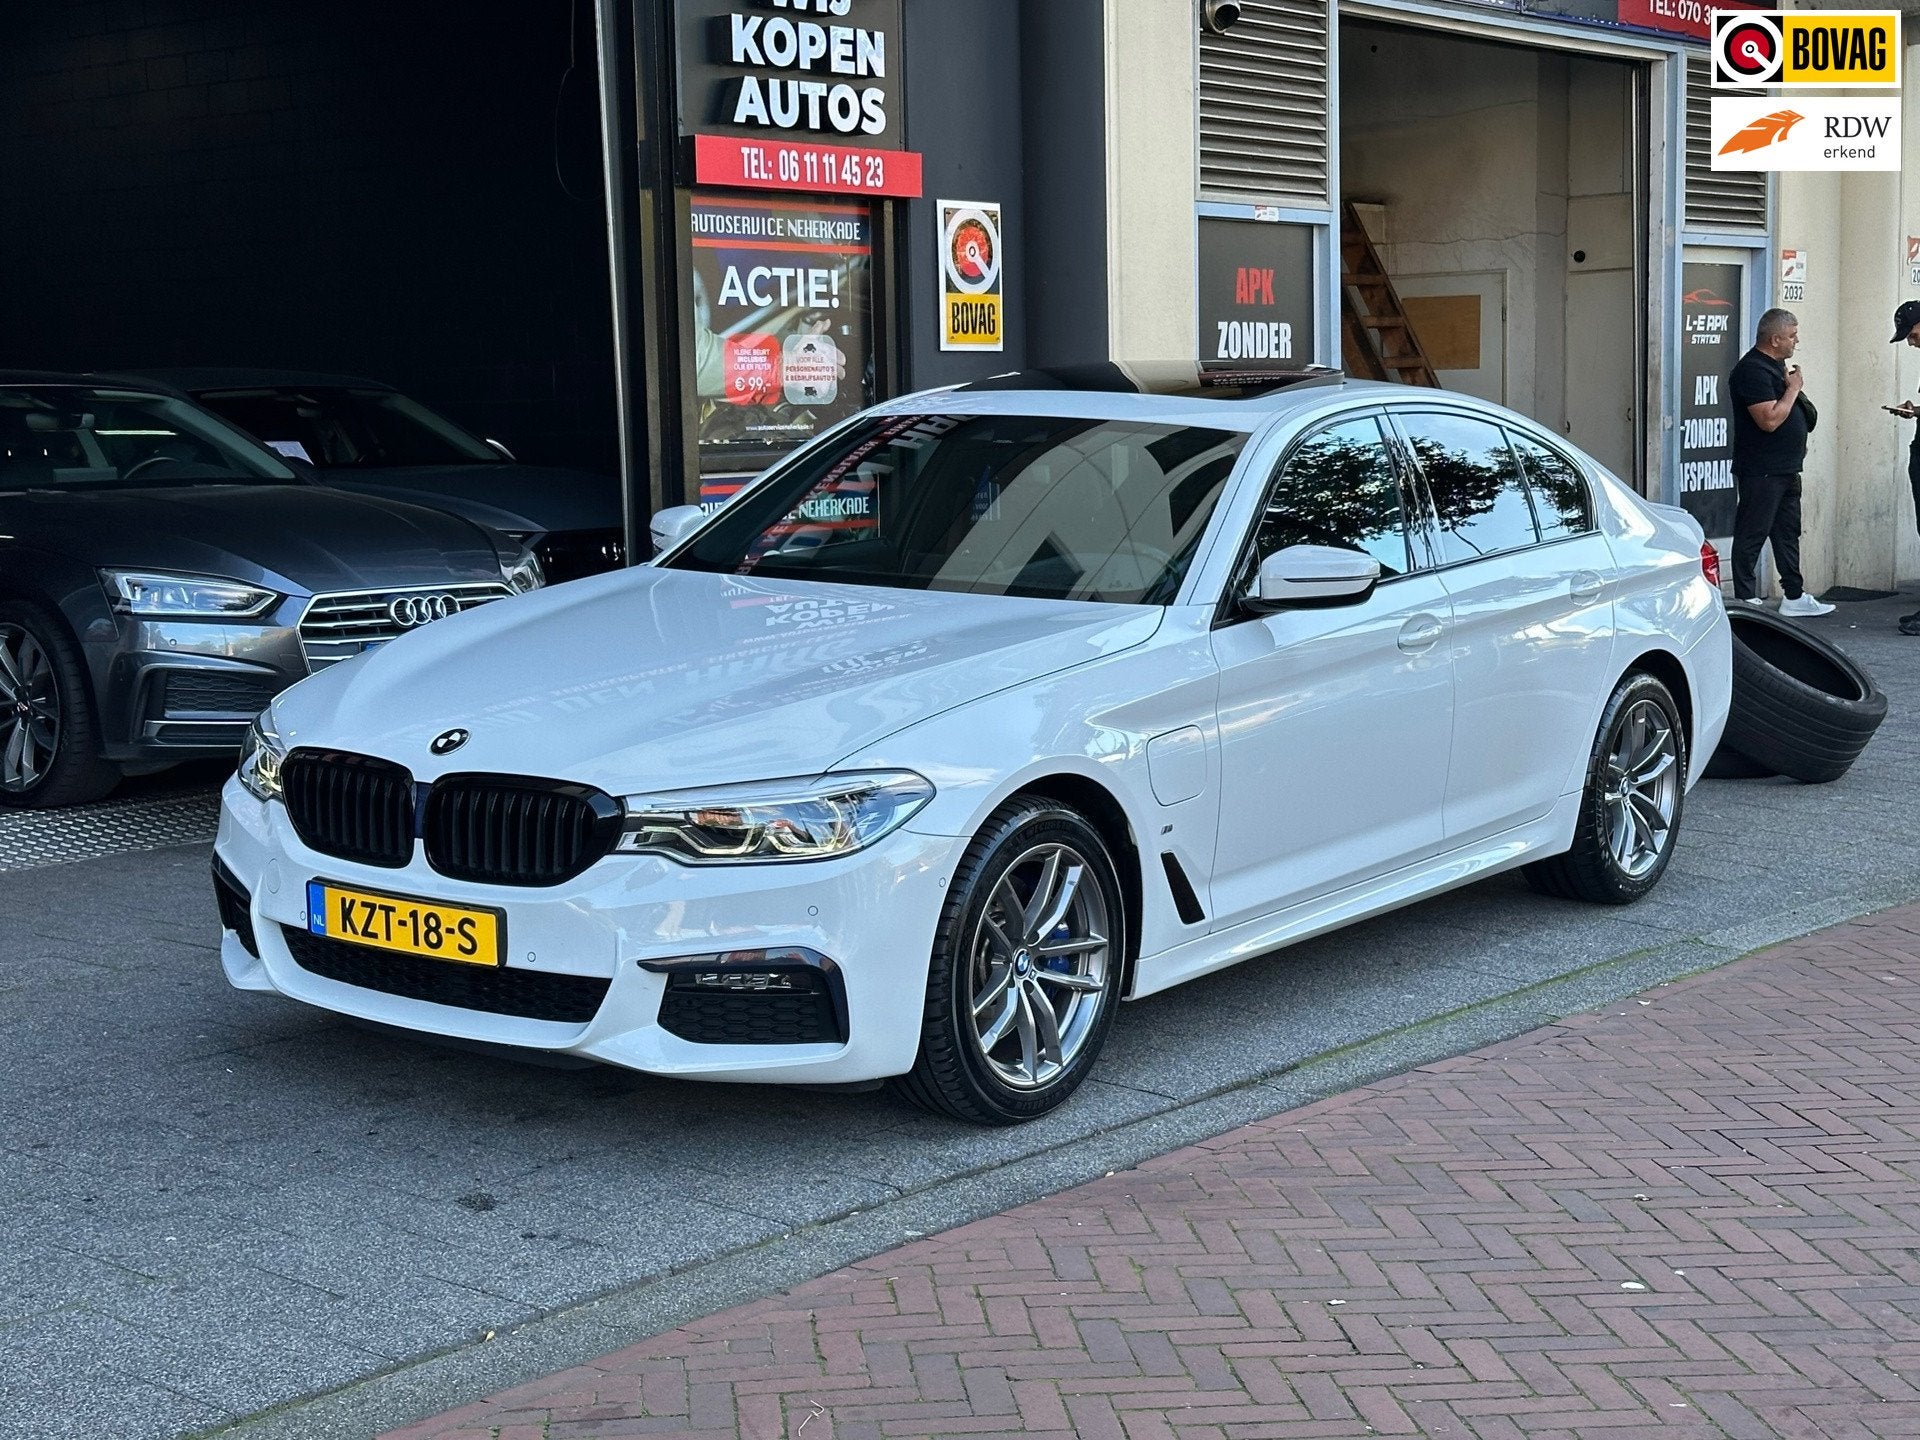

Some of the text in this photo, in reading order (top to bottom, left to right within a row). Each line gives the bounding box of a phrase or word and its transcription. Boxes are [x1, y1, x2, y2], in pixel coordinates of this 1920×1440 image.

[1678, 0, 1701, 23] 070
[731, 13, 885, 78] KOPEN
[733, 75, 887, 135] AUTOS
[741, 146, 884, 188] TEL: 06 11 11 45 23
[691, 213, 861, 241] AUTOSERVICE NEHERKADE
[718, 265, 840, 309] ACTIE!
[1236, 267, 1275, 305] APK
[1784, 285, 1803, 300] 2032
[951, 302, 996, 335] BOVAG
[1217, 321, 1292, 359] ZONDER
[1691, 334, 1721, 345] STATION
[1695, 375, 1718, 406] APK
[1684, 417, 1727, 449] ZONDER
[799, 497, 870, 517] NEHERKADE
[313, 913, 324, 927] NL
[340, 896, 478, 955] KZT-18-S
